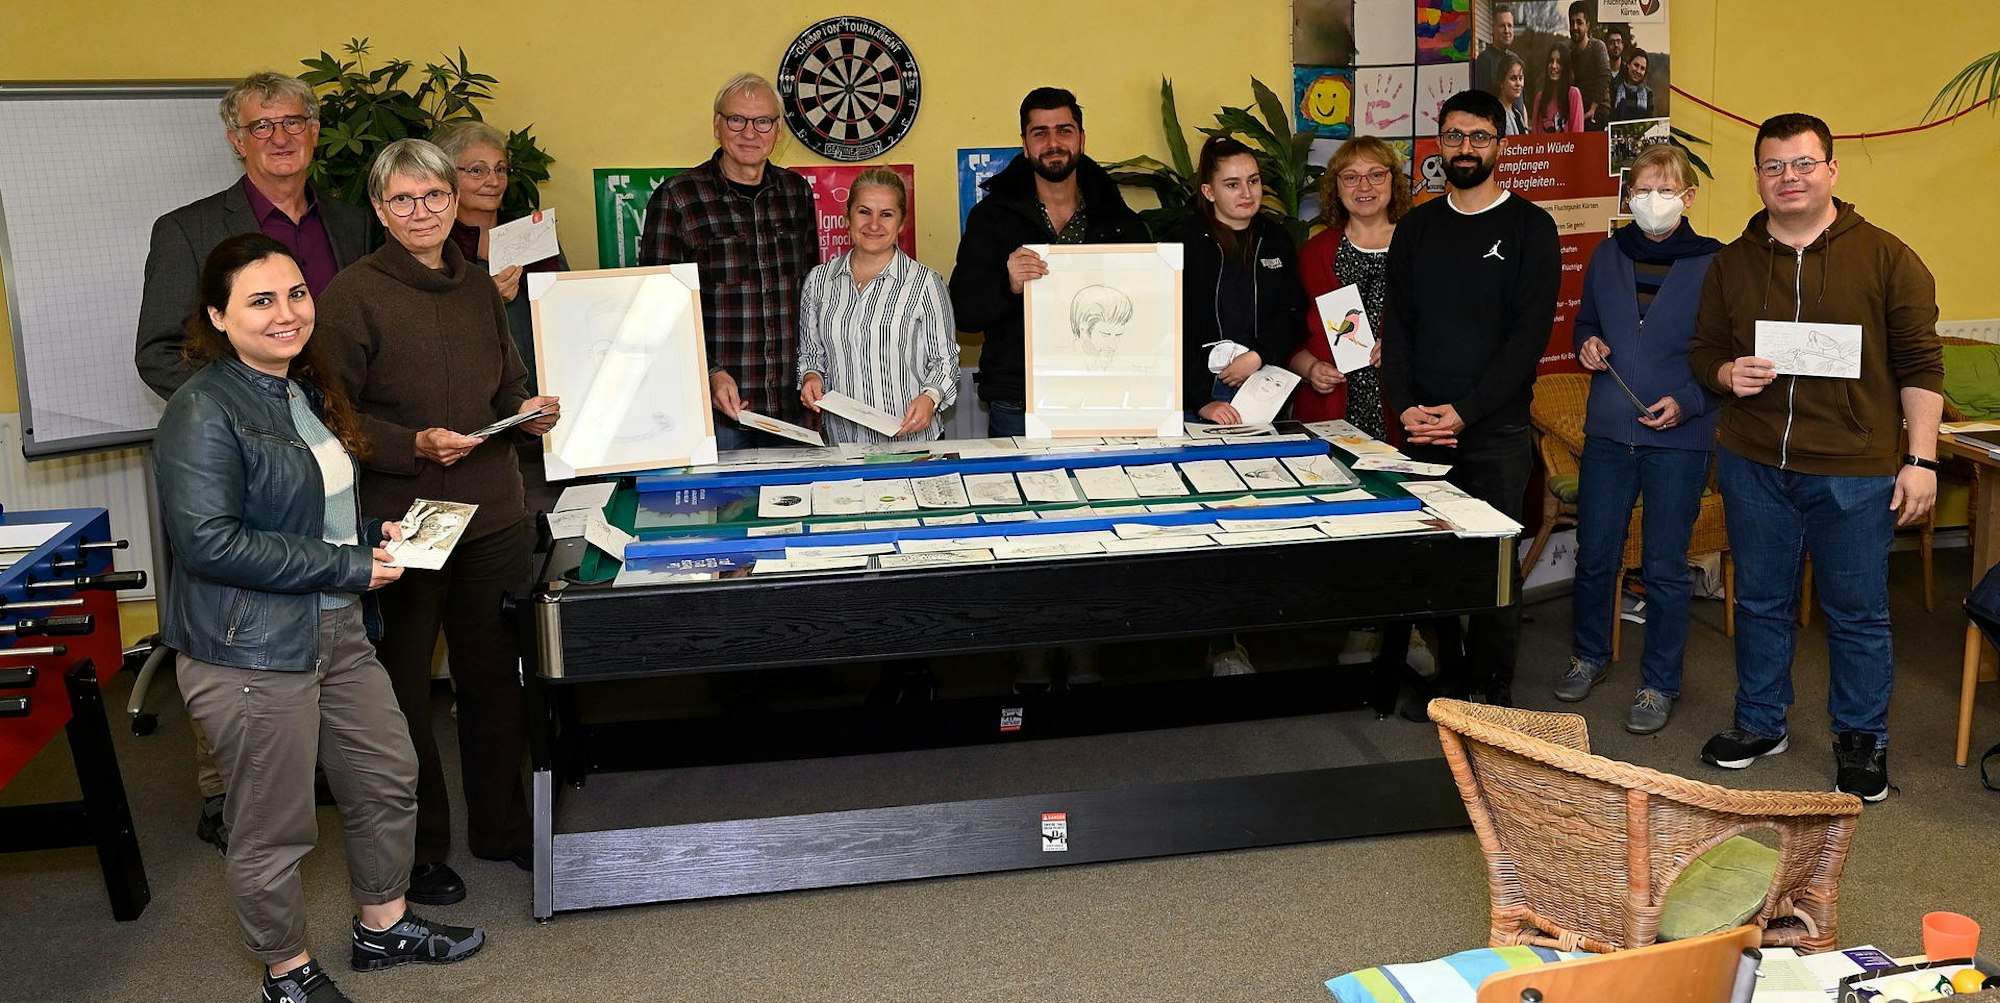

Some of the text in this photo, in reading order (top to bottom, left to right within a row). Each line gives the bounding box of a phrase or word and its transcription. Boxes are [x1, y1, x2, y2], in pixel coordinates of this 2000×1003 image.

[796, 21, 901, 55] CHAMPION TOURNAMENT
[1535, 142, 1545, 154] in
[1547, 141, 1575, 153] Würde
[1498, 158, 1550, 174] empfangen
[1513, 175, 1556, 192] begleiten
[820, 231, 830, 247] ist
